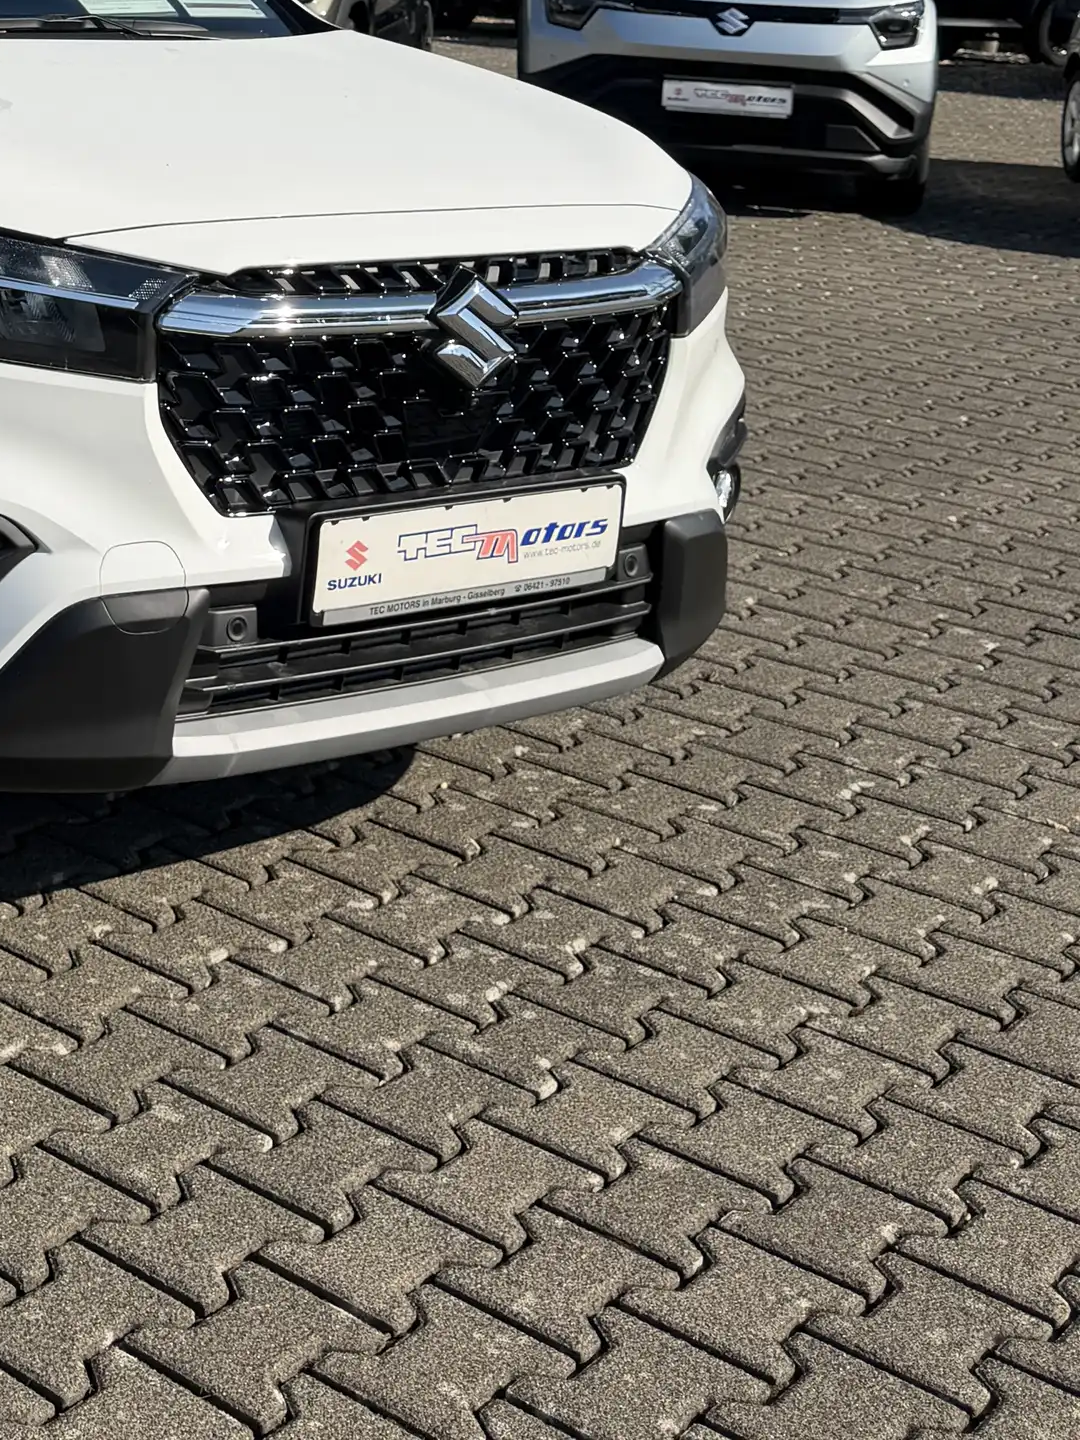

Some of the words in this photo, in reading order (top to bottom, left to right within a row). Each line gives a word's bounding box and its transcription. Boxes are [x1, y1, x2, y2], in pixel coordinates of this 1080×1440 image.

[327, 573, 382, 591] SUZUKI
[370, 605, 385, 616] TEC
[387, 599, 421, 613] MOTORS
[422, 598, 430, 607] in
[431, 593, 462, 607] Marburg
[467, 586, 506, 601] Gisselberg
